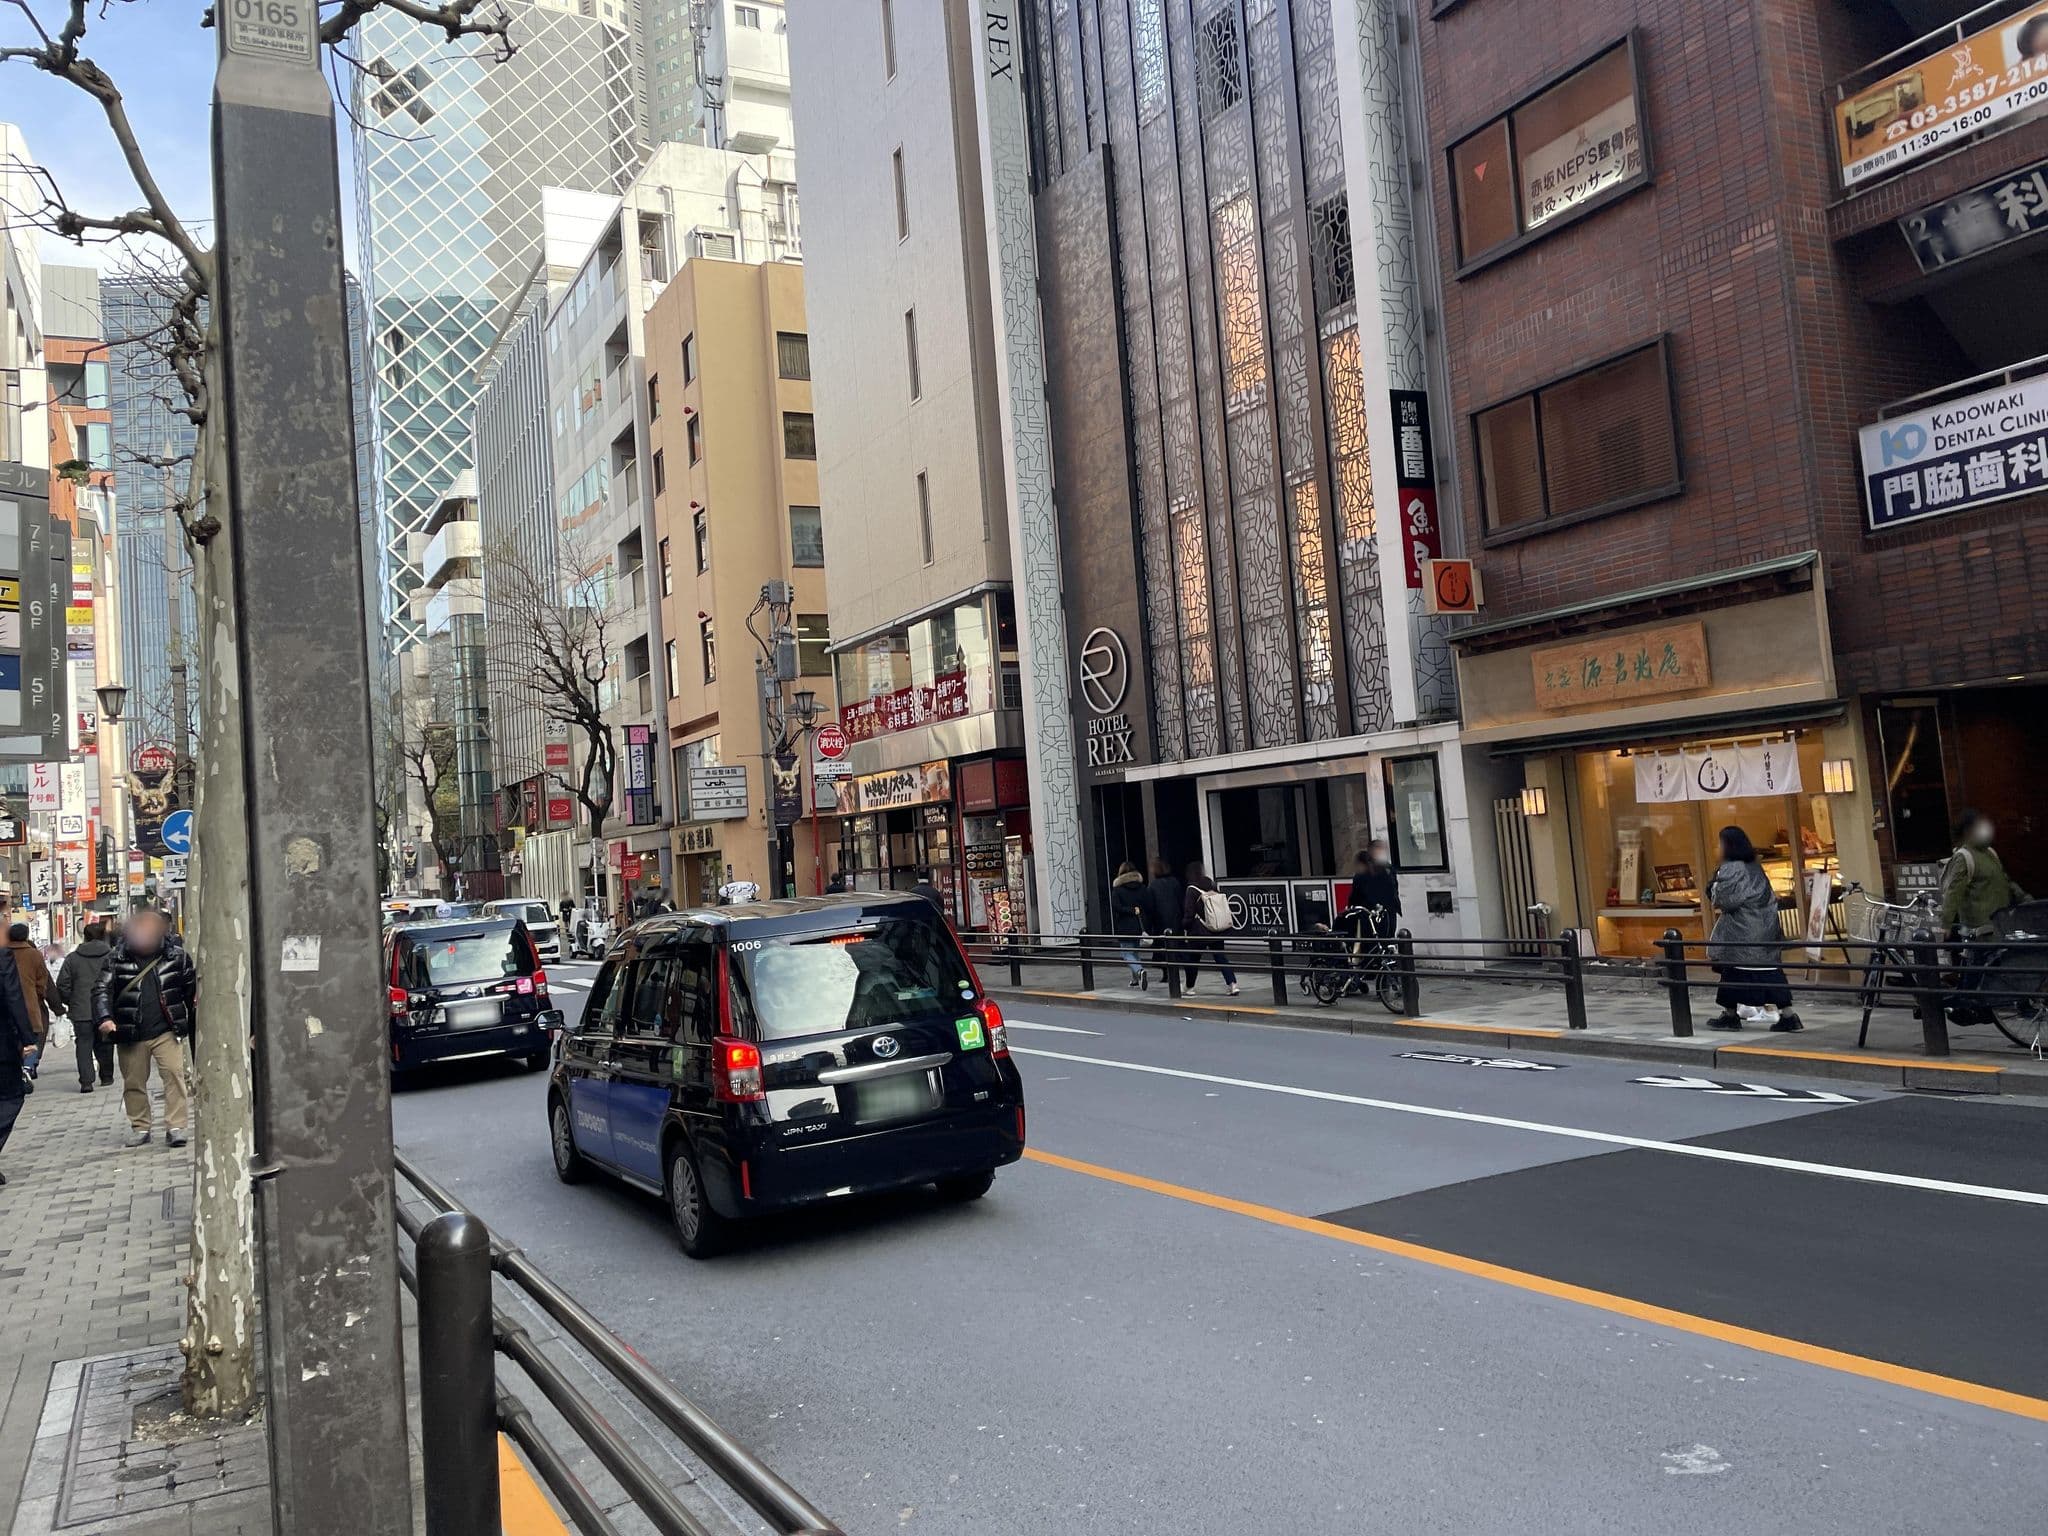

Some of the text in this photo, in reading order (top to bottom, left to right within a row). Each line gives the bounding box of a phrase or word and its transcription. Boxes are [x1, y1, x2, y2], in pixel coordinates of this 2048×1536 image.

[234, 0, 298, 27] 0165
[986, 11, 1012, 82] REX
[1909, 52, 2048, 129] 03-3587-214
[1932, 393, 2024, 430] KADOWAKI
[1935, 409, 2048, 450] DENTAL CLINI
[1883, 437, 2048, 516] 門脇歯科
[1088, 714, 1129, 735] HOTEL
[820, 736, 844, 749] 消火栓
[1086, 731, 1134, 767] REX
[1248, 893, 1283, 905] HOTEL
[1249, 906, 1284, 925] REX
[731, 941, 762, 953] 1006
